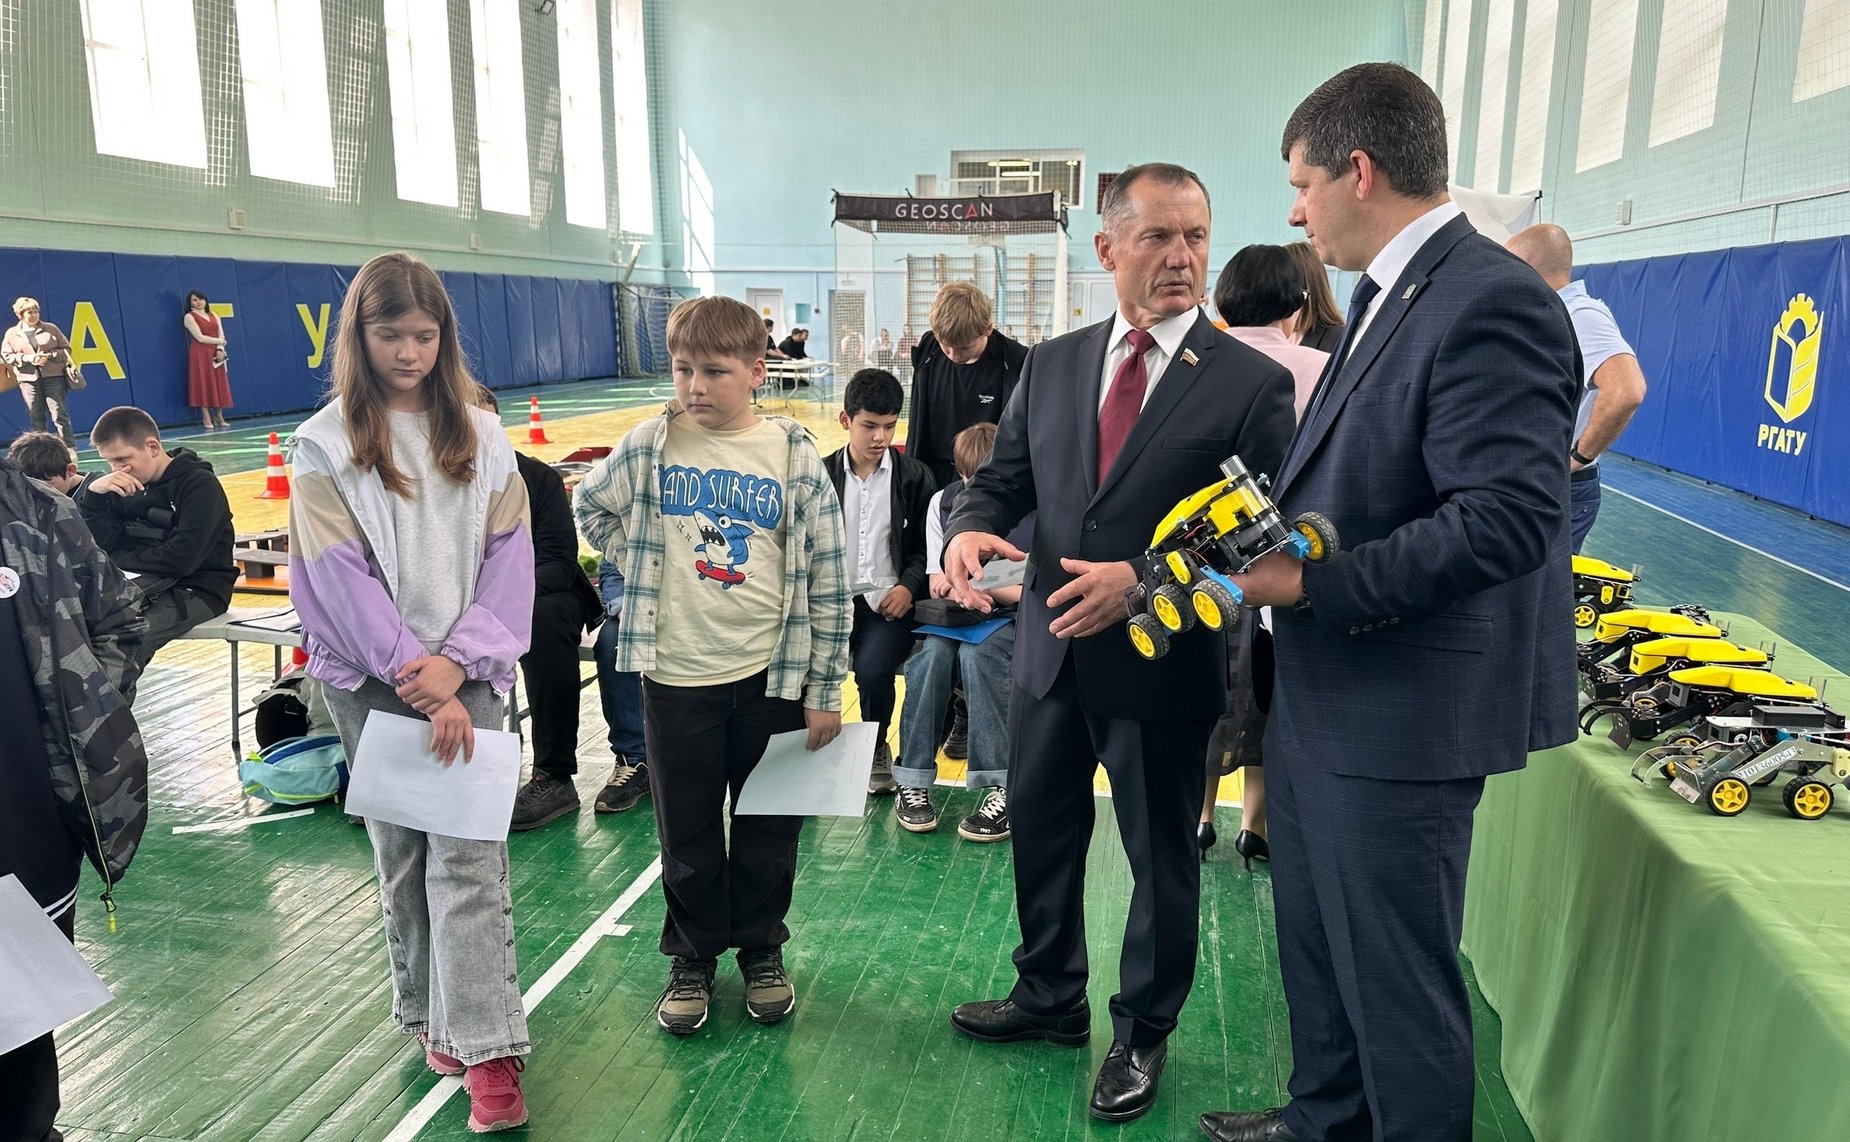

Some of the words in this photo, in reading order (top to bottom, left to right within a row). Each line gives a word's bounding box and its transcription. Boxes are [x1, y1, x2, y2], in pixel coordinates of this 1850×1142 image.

[894, 203, 994, 220] GEOSCAN
[1757, 423, 1807, 456] РГАТУ
[661, 470, 701, 507] AND
[707, 473, 780, 522] SURFER
